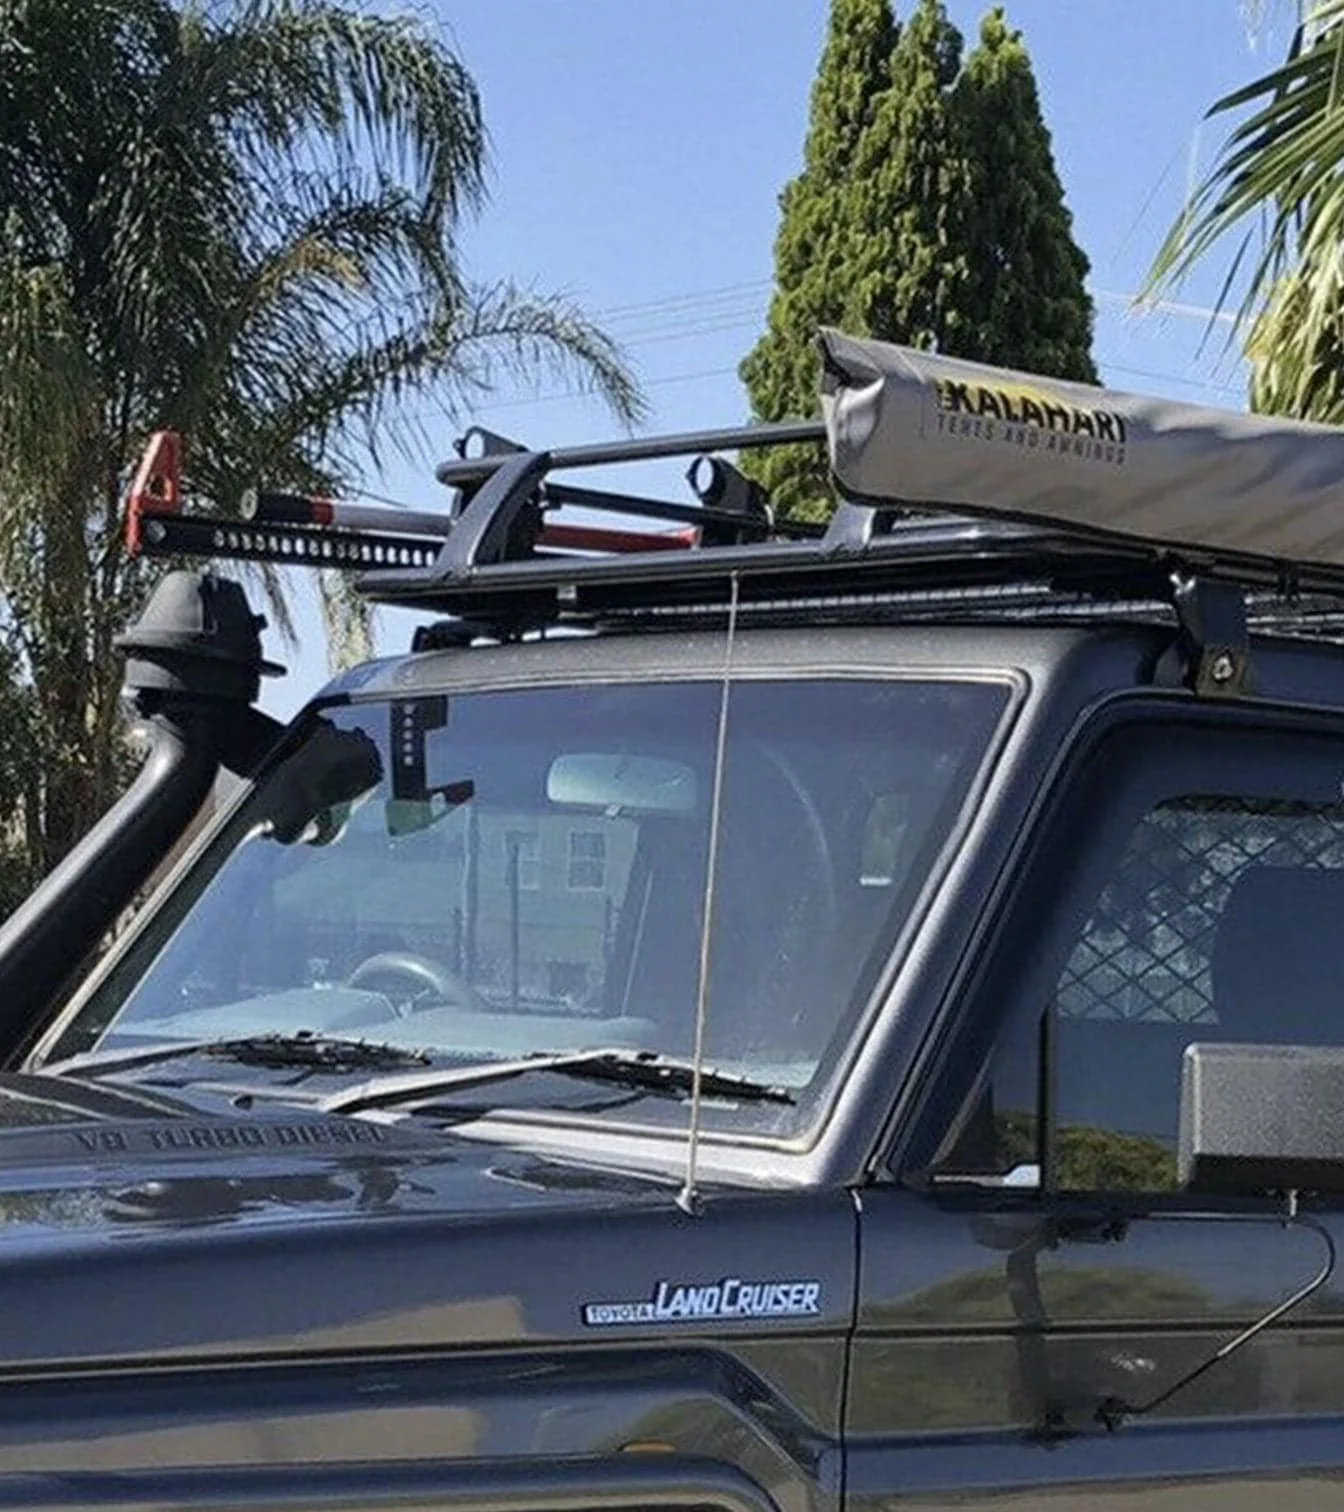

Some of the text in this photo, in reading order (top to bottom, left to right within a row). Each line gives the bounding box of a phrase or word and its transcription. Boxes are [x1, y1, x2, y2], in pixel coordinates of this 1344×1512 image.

[940, 378, 1126, 444] KALAHARI
[144, 1125, 269, 1150] TURBO
[274, 1121, 386, 1148] DIESEL
[587, 1304, 655, 1324] TOYOTA
